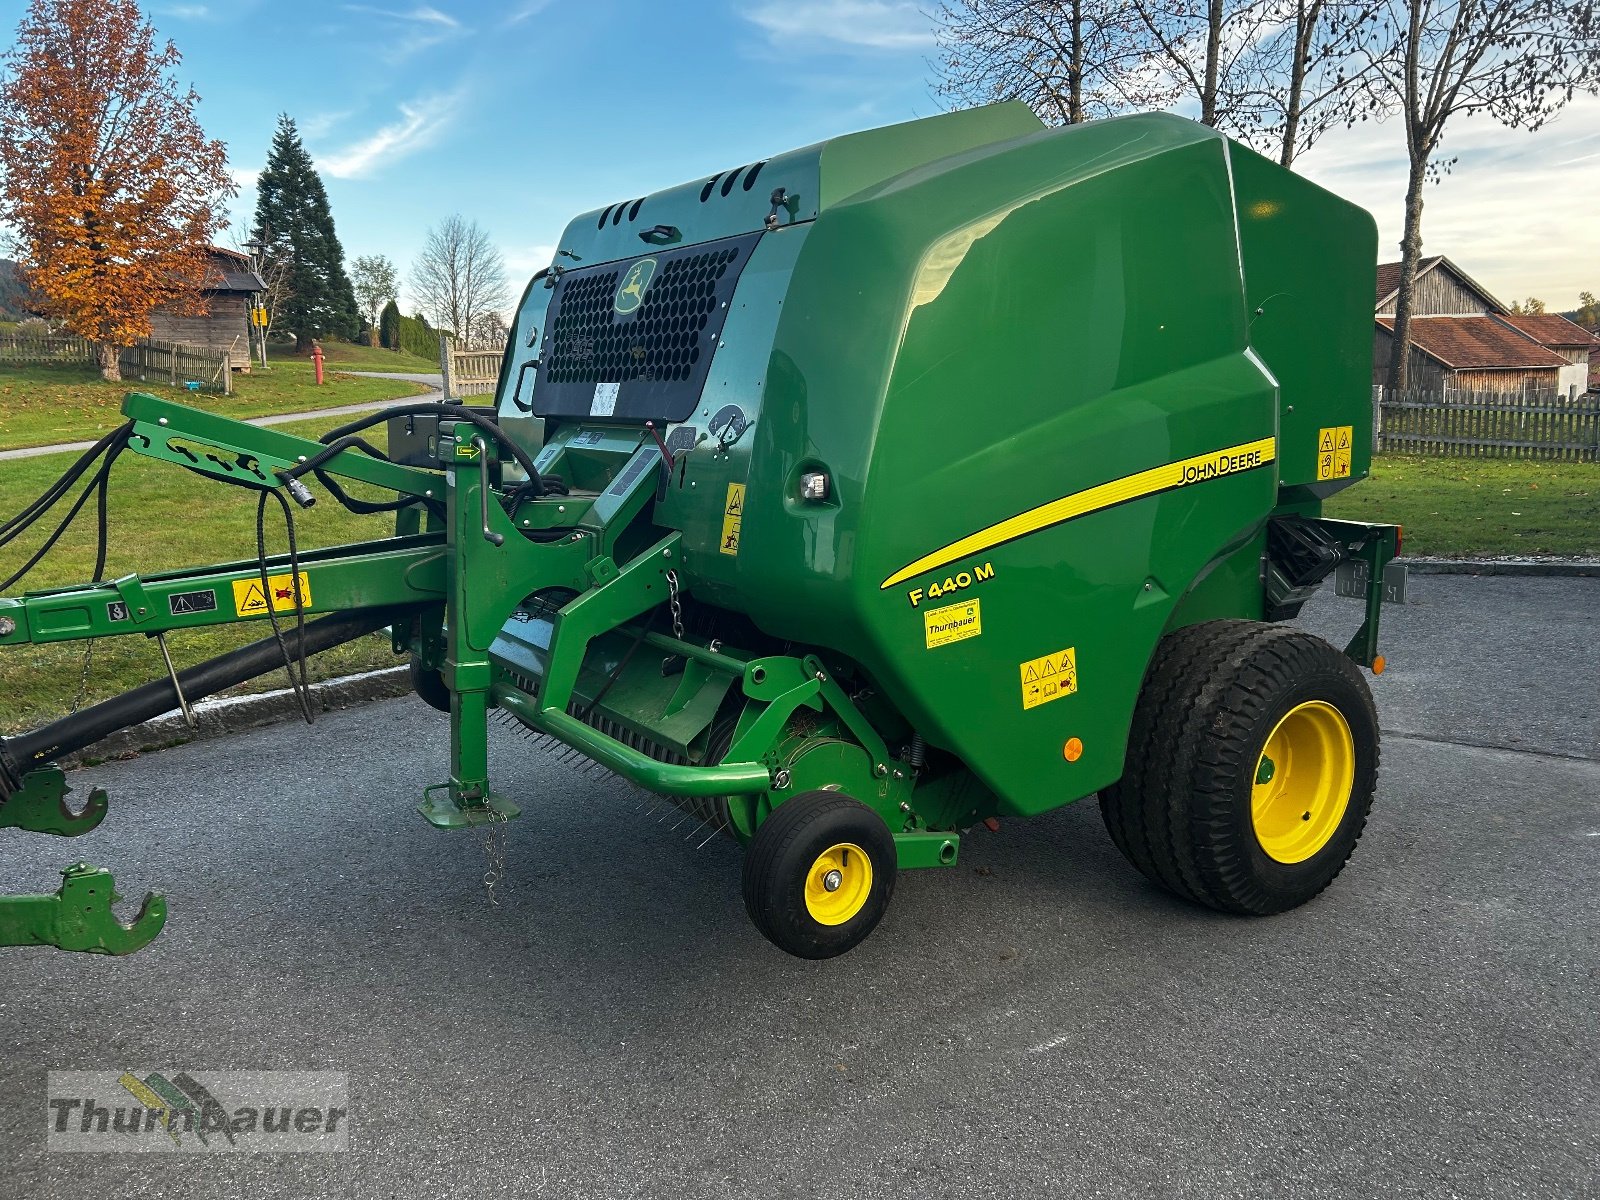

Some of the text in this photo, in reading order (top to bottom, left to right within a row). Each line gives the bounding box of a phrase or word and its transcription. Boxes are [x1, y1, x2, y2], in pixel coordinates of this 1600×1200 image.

[1177, 450, 1261, 484] JOHN DEERE
[908, 562, 995, 607] F 440 M
[929, 616, 976, 634] Thurnbauer
